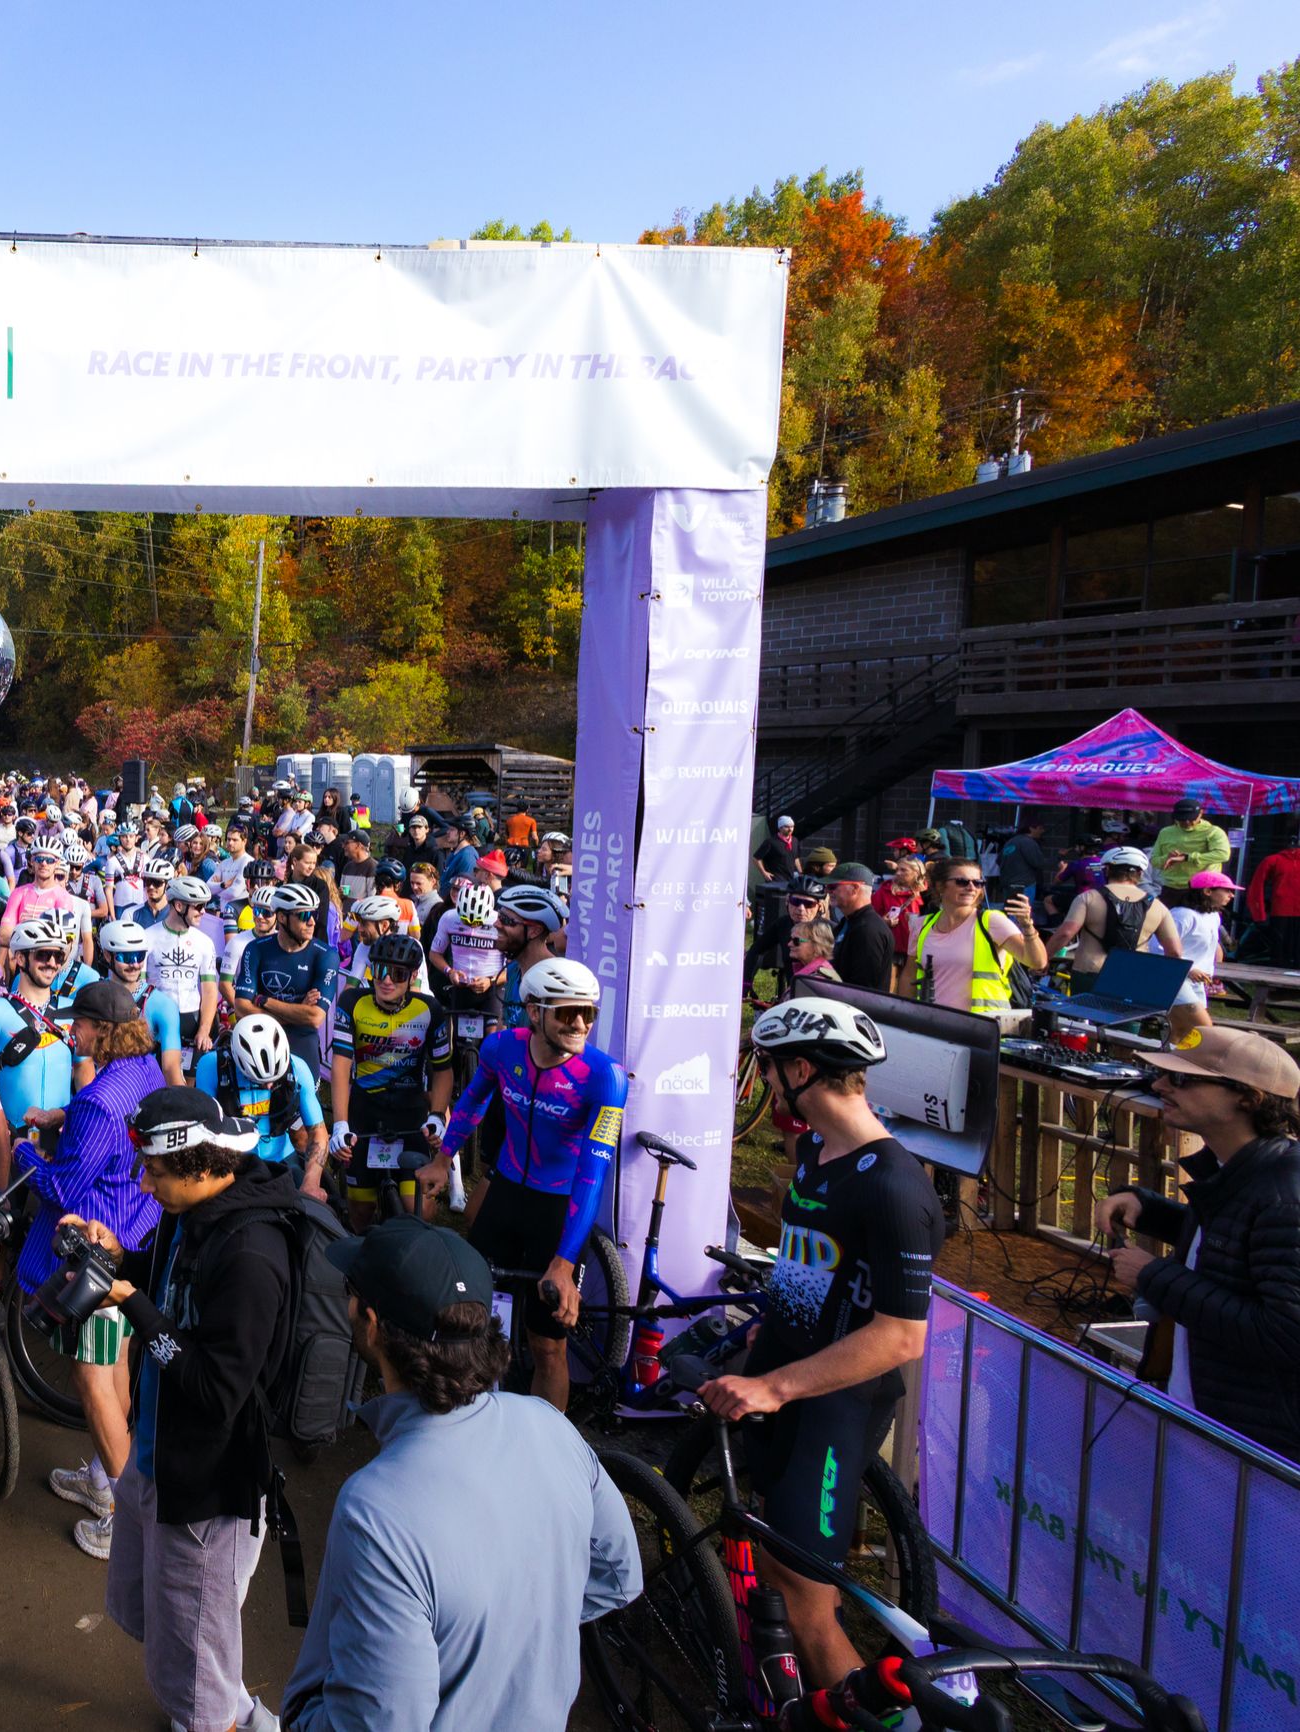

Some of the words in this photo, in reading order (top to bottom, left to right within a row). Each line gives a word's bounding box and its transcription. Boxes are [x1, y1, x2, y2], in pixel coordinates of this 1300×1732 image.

[87, 350, 172, 377] RACE
[177, 351, 214, 378] IN
[220, 352, 284, 379] THE
[287, 352, 402, 386] FRONT,
[415, 353, 527, 382] PARTY
[529, 353, 564, 380] IN
[569, 353, 631, 381] THE
[638, 354, 703, 382] BAC
[701, 578, 738, 589] VILLA
[700, 590, 752, 602] TOYOTA
[683, 648, 750, 660] DEVINCI
[661, 701, 749, 715] OUTAOUAIS
[1056, 763, 1158, 773] BRAQUET
[655, 827, 738, 845] WILLIAM
[605, 832, 624, 925] PARC
[651, 882, 735, 895] CHELSEA
[673, 901, 686, 912] &
[599, 932, 617, 979] DU
[676, 951, 730, 966] DUSK
[643, 1005, 661, 1018] LE
[663, 1004, 729, 1018] BRAQUET
[359, 1033, 397, 1046] RIDE
[661, 1074, 704, 1092] näak
[503, 1086, 571, 1116] DEVINCI
[166, 1130, 188, 1149] 99
[655, 1130, 702, 1147] ébec
[819, 1445, 840, 1538] FELT
